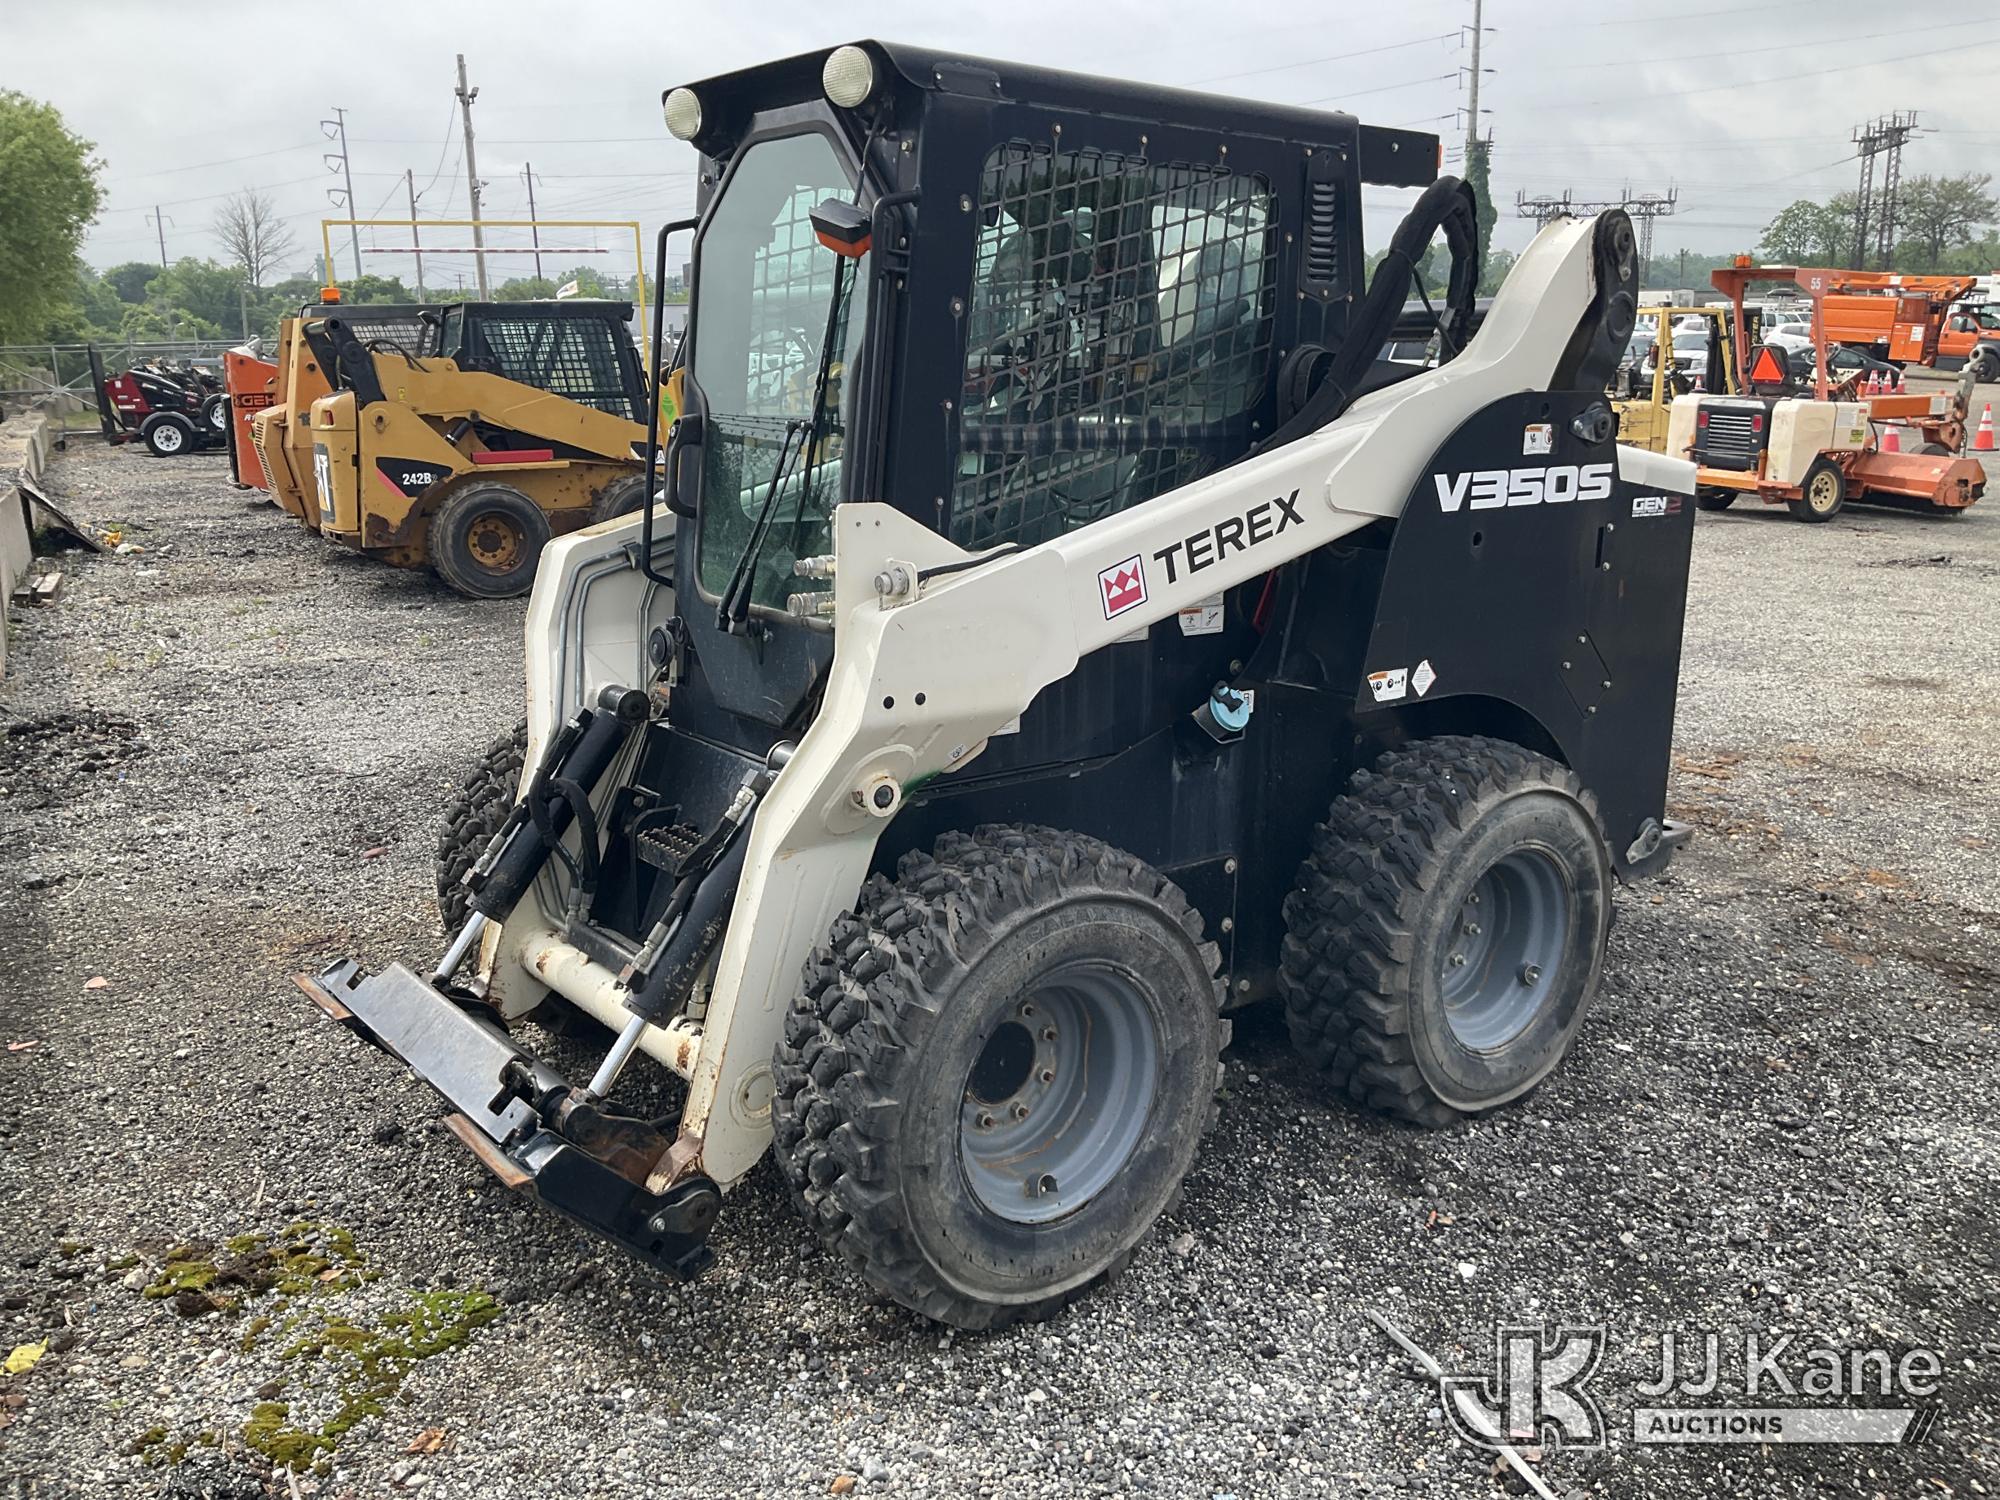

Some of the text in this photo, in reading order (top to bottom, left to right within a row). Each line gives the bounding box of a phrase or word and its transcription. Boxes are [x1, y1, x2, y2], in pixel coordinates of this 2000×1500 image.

[1811, 278, 1821, 289] 55
[240, 395, 276, 406] GEH
[402, 472, 432, 485] 242B
[1434, 463, 1613, 512] V350S
[1153, 488, 1305, 584] TEREX
